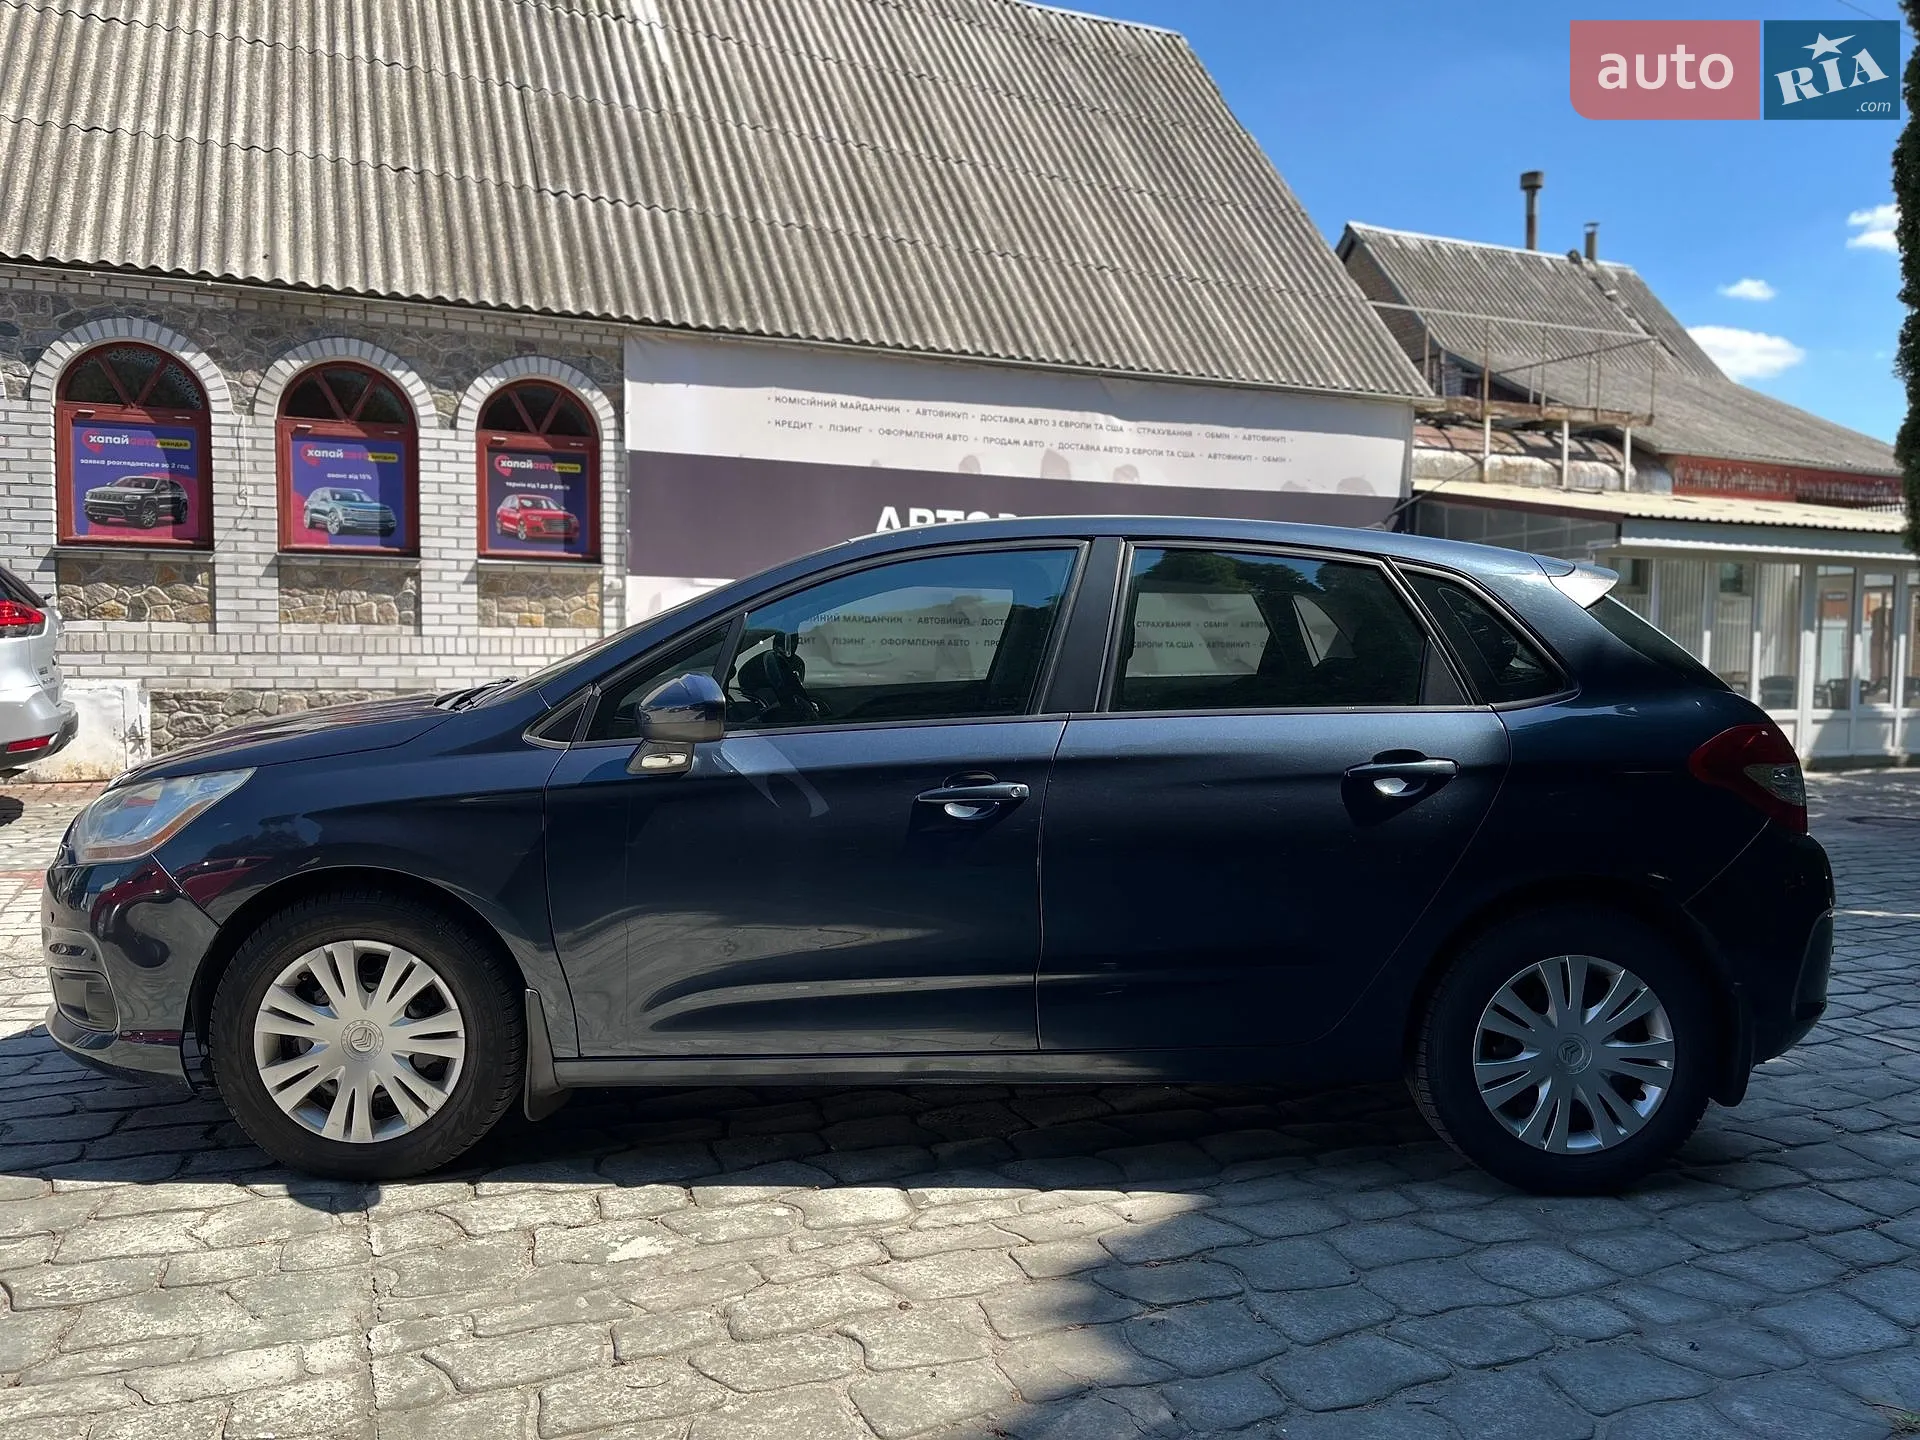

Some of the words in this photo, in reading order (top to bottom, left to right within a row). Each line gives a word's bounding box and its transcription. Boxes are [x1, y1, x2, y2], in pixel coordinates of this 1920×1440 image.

[775, 395, 837, 409] КОМІСІЙНИЙ
[840, 399, 900, 414] МАЙДАНЧИК
[915, 408, 969, 420] АВТОВИКУП
[980, 414, 1025, 425] ДОСТАВКА
[1027, 418, 1049, 427] АВТО
[1059, 420, 1092, 430] ЄВРОПИ
[1094, 423, 1103, 431] ТА
[1105, 424, 1124, 433] США
[1137, 427, 1192, 437] СТРАХУВАННЯ
[1205, 431, 1230, 440] ОБМІН
[1242, 434, 1287, 443] АВТОВИКУП
[775, 420, 813, 430] КРЕДИТ
[829, 423, 863, 433] ЛІЗИНГ
[878, 427, 943, 441] ОФОРМЛЕННЯ
[945, 433, 969, 442] АВТО
[983, 436, 1020, 447] ПРОДАЖ
[1023, 440, 1045, 448] АВТО
[1058, 442, 1100, 452] ДОСТАВКА
[1103, 446, 1124, 454] АВТО
[1132, 447, 1164, 457] ЄВРОПИ
[1166, 449, 1175, 457] ТА
[1177, 450, 1195, 459] США
[1207, 452, 1252, 462] АВТОВИКУП
[1262, 455, 1286, 463] ОБМІН
[880, 637, 945, 647] ОФОРМЛЕННЯ
